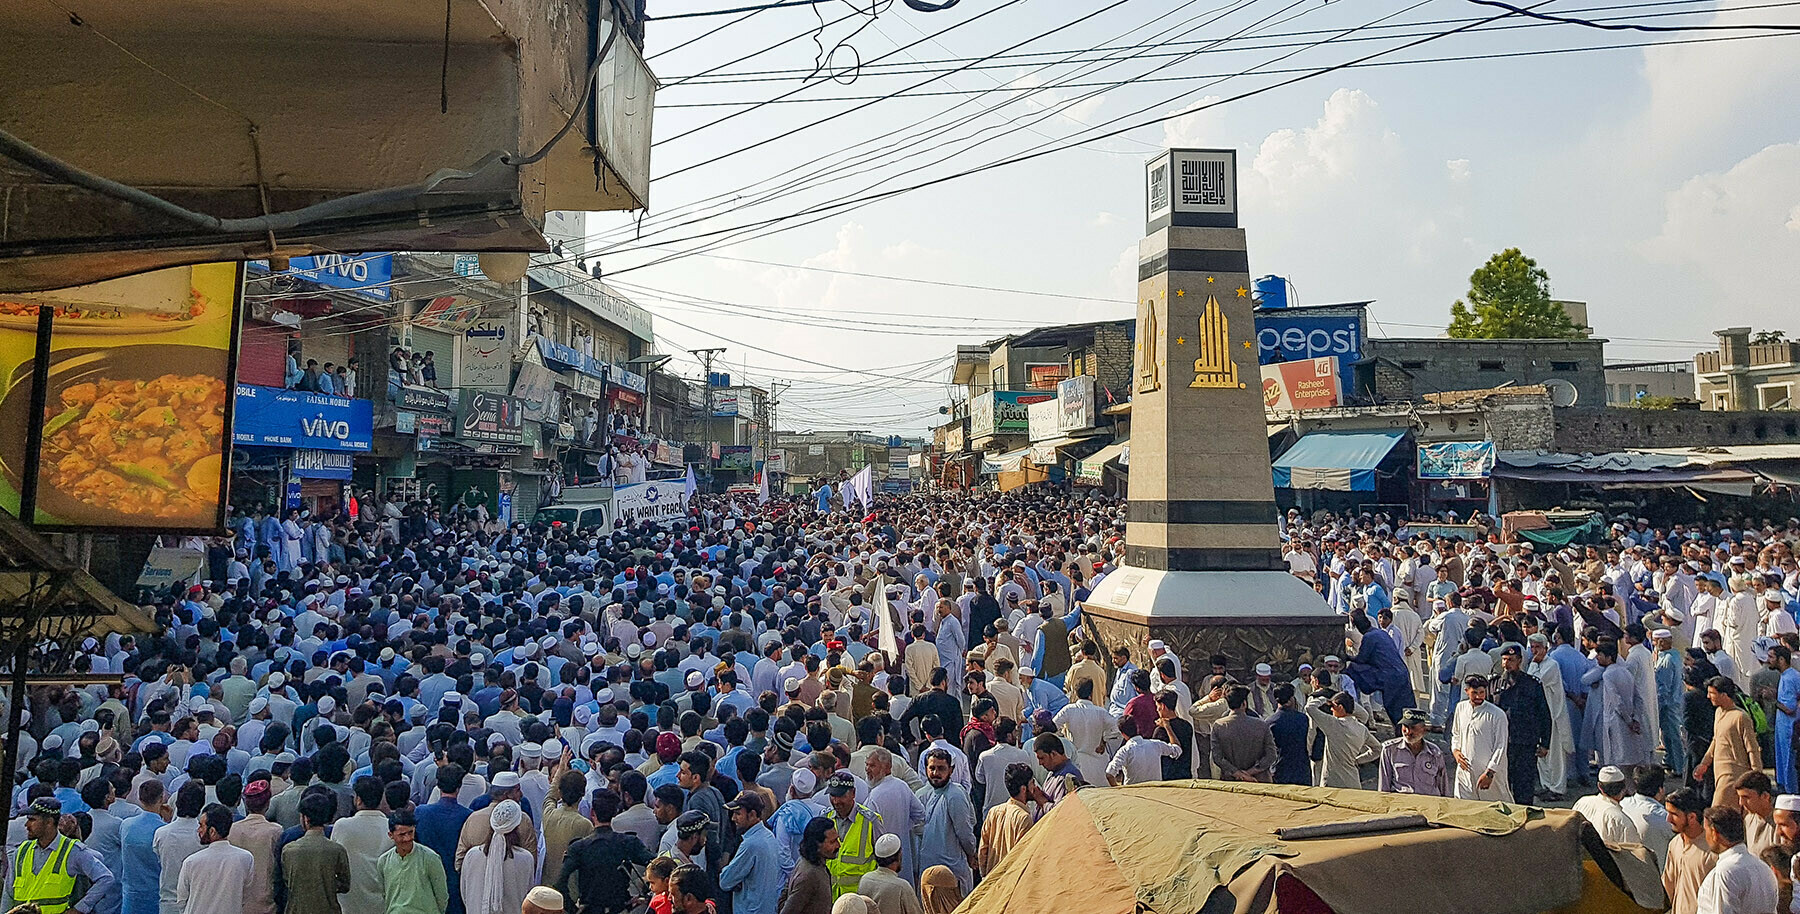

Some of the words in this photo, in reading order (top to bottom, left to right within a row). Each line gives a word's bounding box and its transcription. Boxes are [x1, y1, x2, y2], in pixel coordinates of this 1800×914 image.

[1257, 323, 1356, 358] pepsi
[1317, 362, 1328, 374] 4G
[1298, 379, 1324, 389] Rasheed
[236, 386, 256, 398] OBILE
[1295, 388, 1331, 399] Enterprises
[306, 395, 328, 405] FAISAL
[329, 398, 350, 407] MOBILE
[301, 412, 349, 440] vivo
[264, 435, 279, 443] PHONE
[279, 436, 292, 444] BANK
[324, 453, 351, 468] MOBILE
[622, 507, 634, 520] WE
[636, 505, 659, 519] WANT
